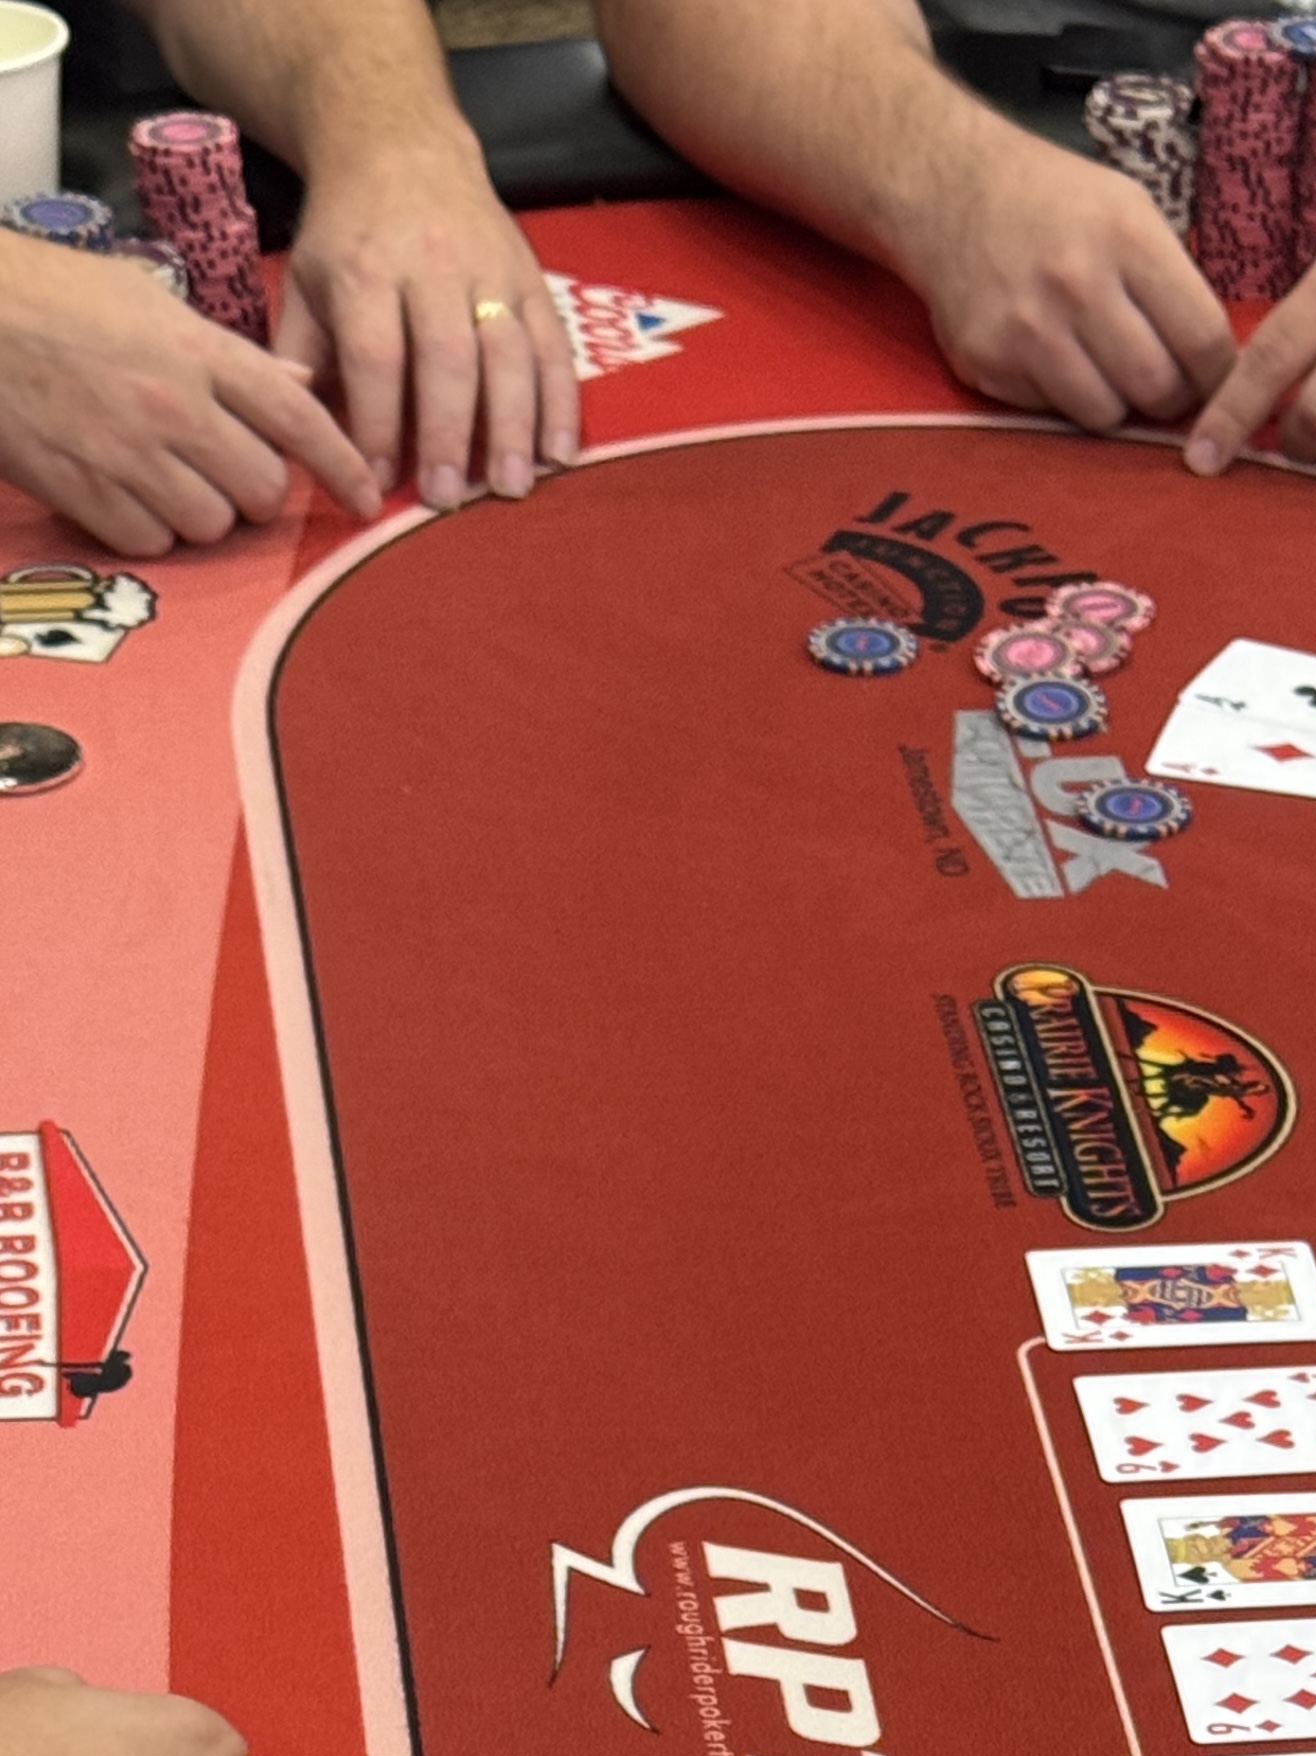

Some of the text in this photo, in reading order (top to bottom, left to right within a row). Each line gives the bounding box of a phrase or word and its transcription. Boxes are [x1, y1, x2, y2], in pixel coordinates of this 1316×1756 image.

[980, 1006, 1028, 1086] CASINO
[1014, 1109, 1060, 1188] RESORT
[1009, 976, 1143, 1218] PRAIRIE KNIGHTS
[1258, 1248, 1297, 1260] K
[0, 1234, 46, 1397] ROOFING
[1062, 1331, 1103, 1343] K
[1115, 1462, 1157, 1474] 9
[1159, 1588, 1205, 1604] K
[1206, 1723, 1250, 1735] 9
